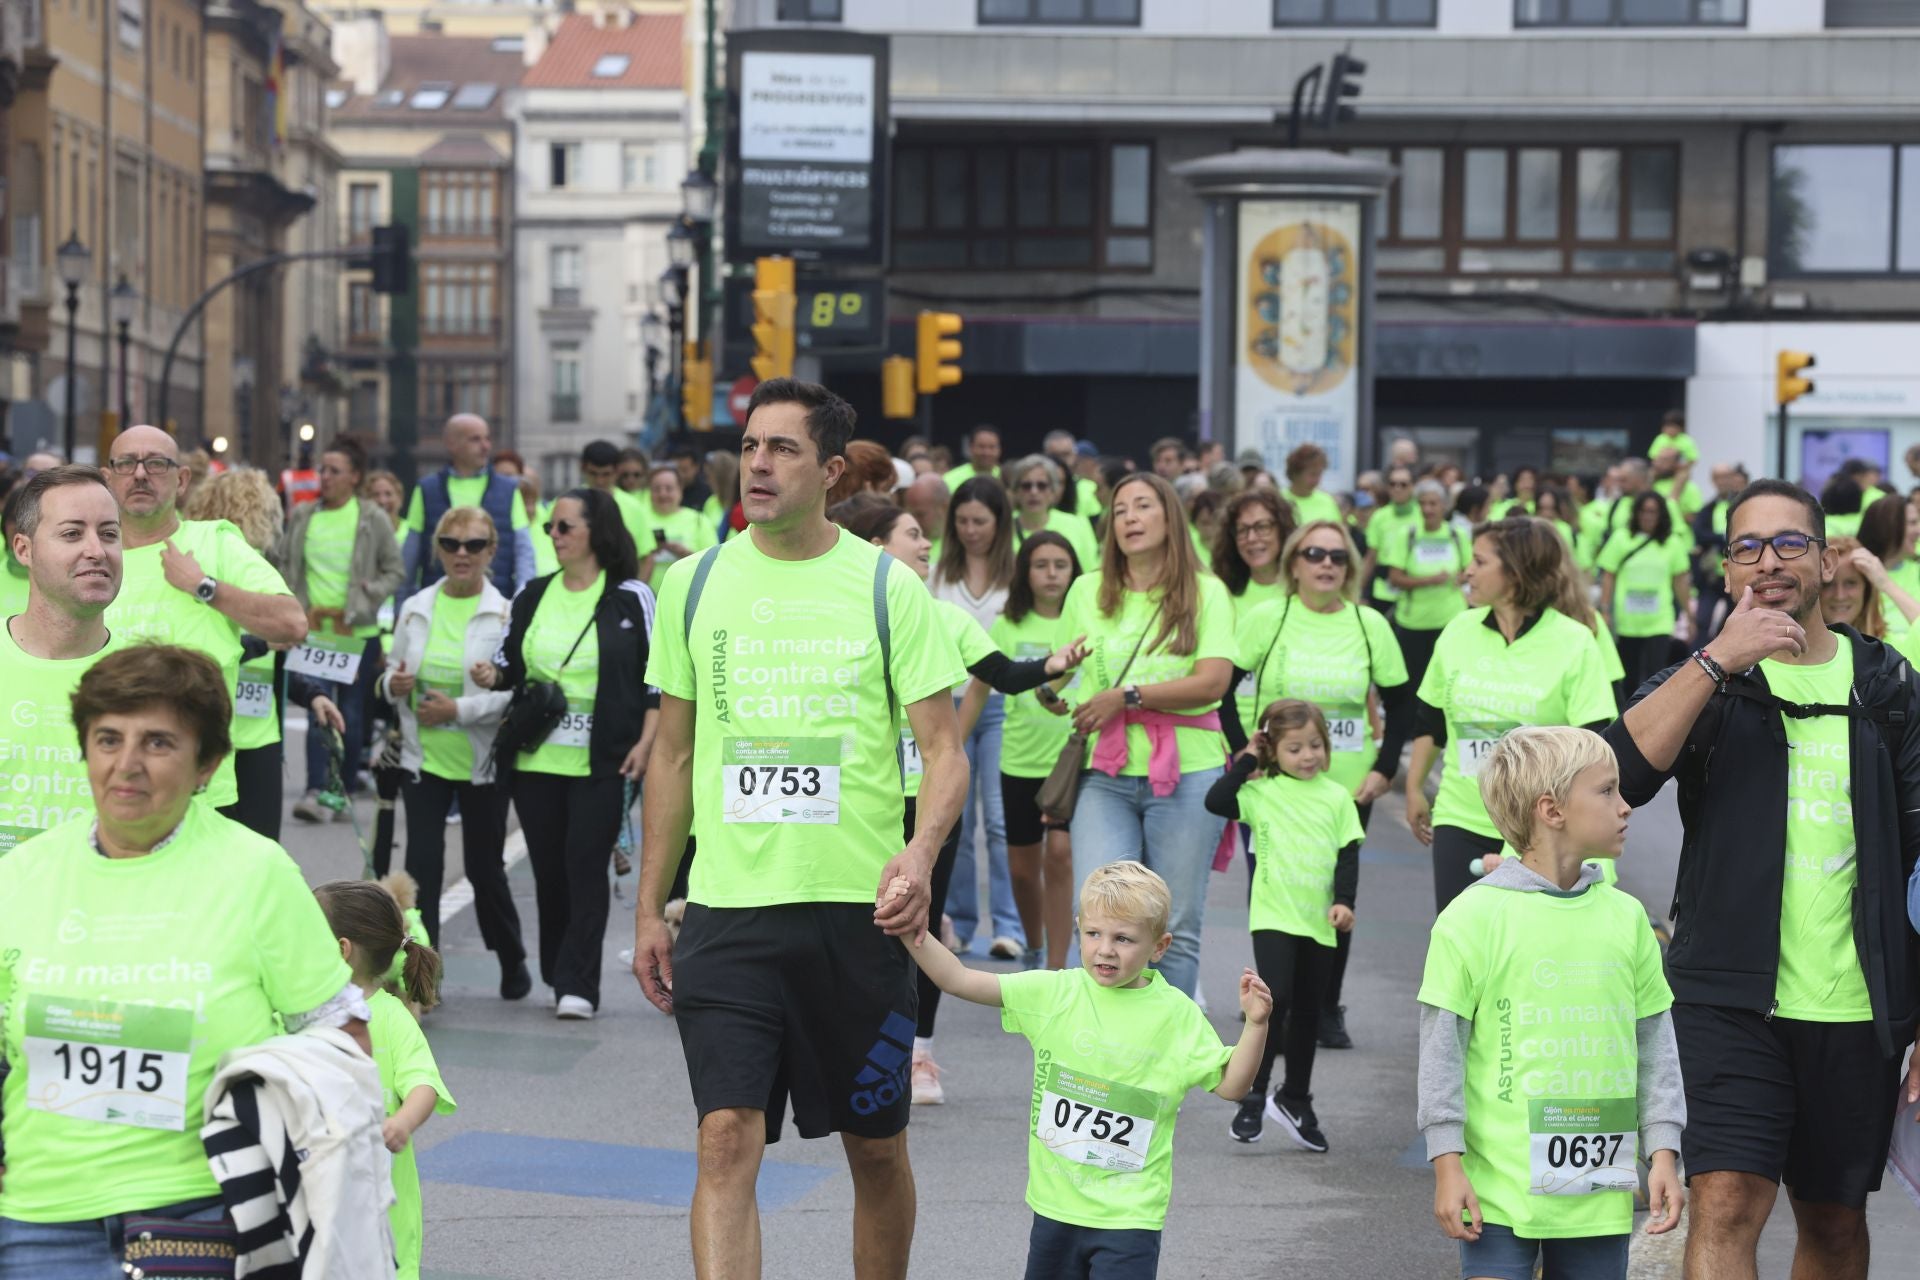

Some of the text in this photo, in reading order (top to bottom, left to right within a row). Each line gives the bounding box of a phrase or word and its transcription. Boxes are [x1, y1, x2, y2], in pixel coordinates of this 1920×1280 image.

[303, 647, 350, 669] 1913
[734, 635, 868, 657] En marcha
[712, 629, 731, 724] ASTURIAS
[733, 660, 861, 686] contra el
[1469, 740, 1500, 759] 10
[739, 766, 821, 797] 0753
[1788, 763, 1837, 791] tra
[24, 956, 213, 985] En marcha
[1518, 1002, 1553, 1026] En
[1496, 998, 1514, 1104] ASTURIAS
[54, 1043, 164, 1093] 1915
[1054, 1098, 1135, 1147] 0752
[1543, 1106, 1563, 1115] Gijón
[1547, 1134, 1624, 1169] 0637
